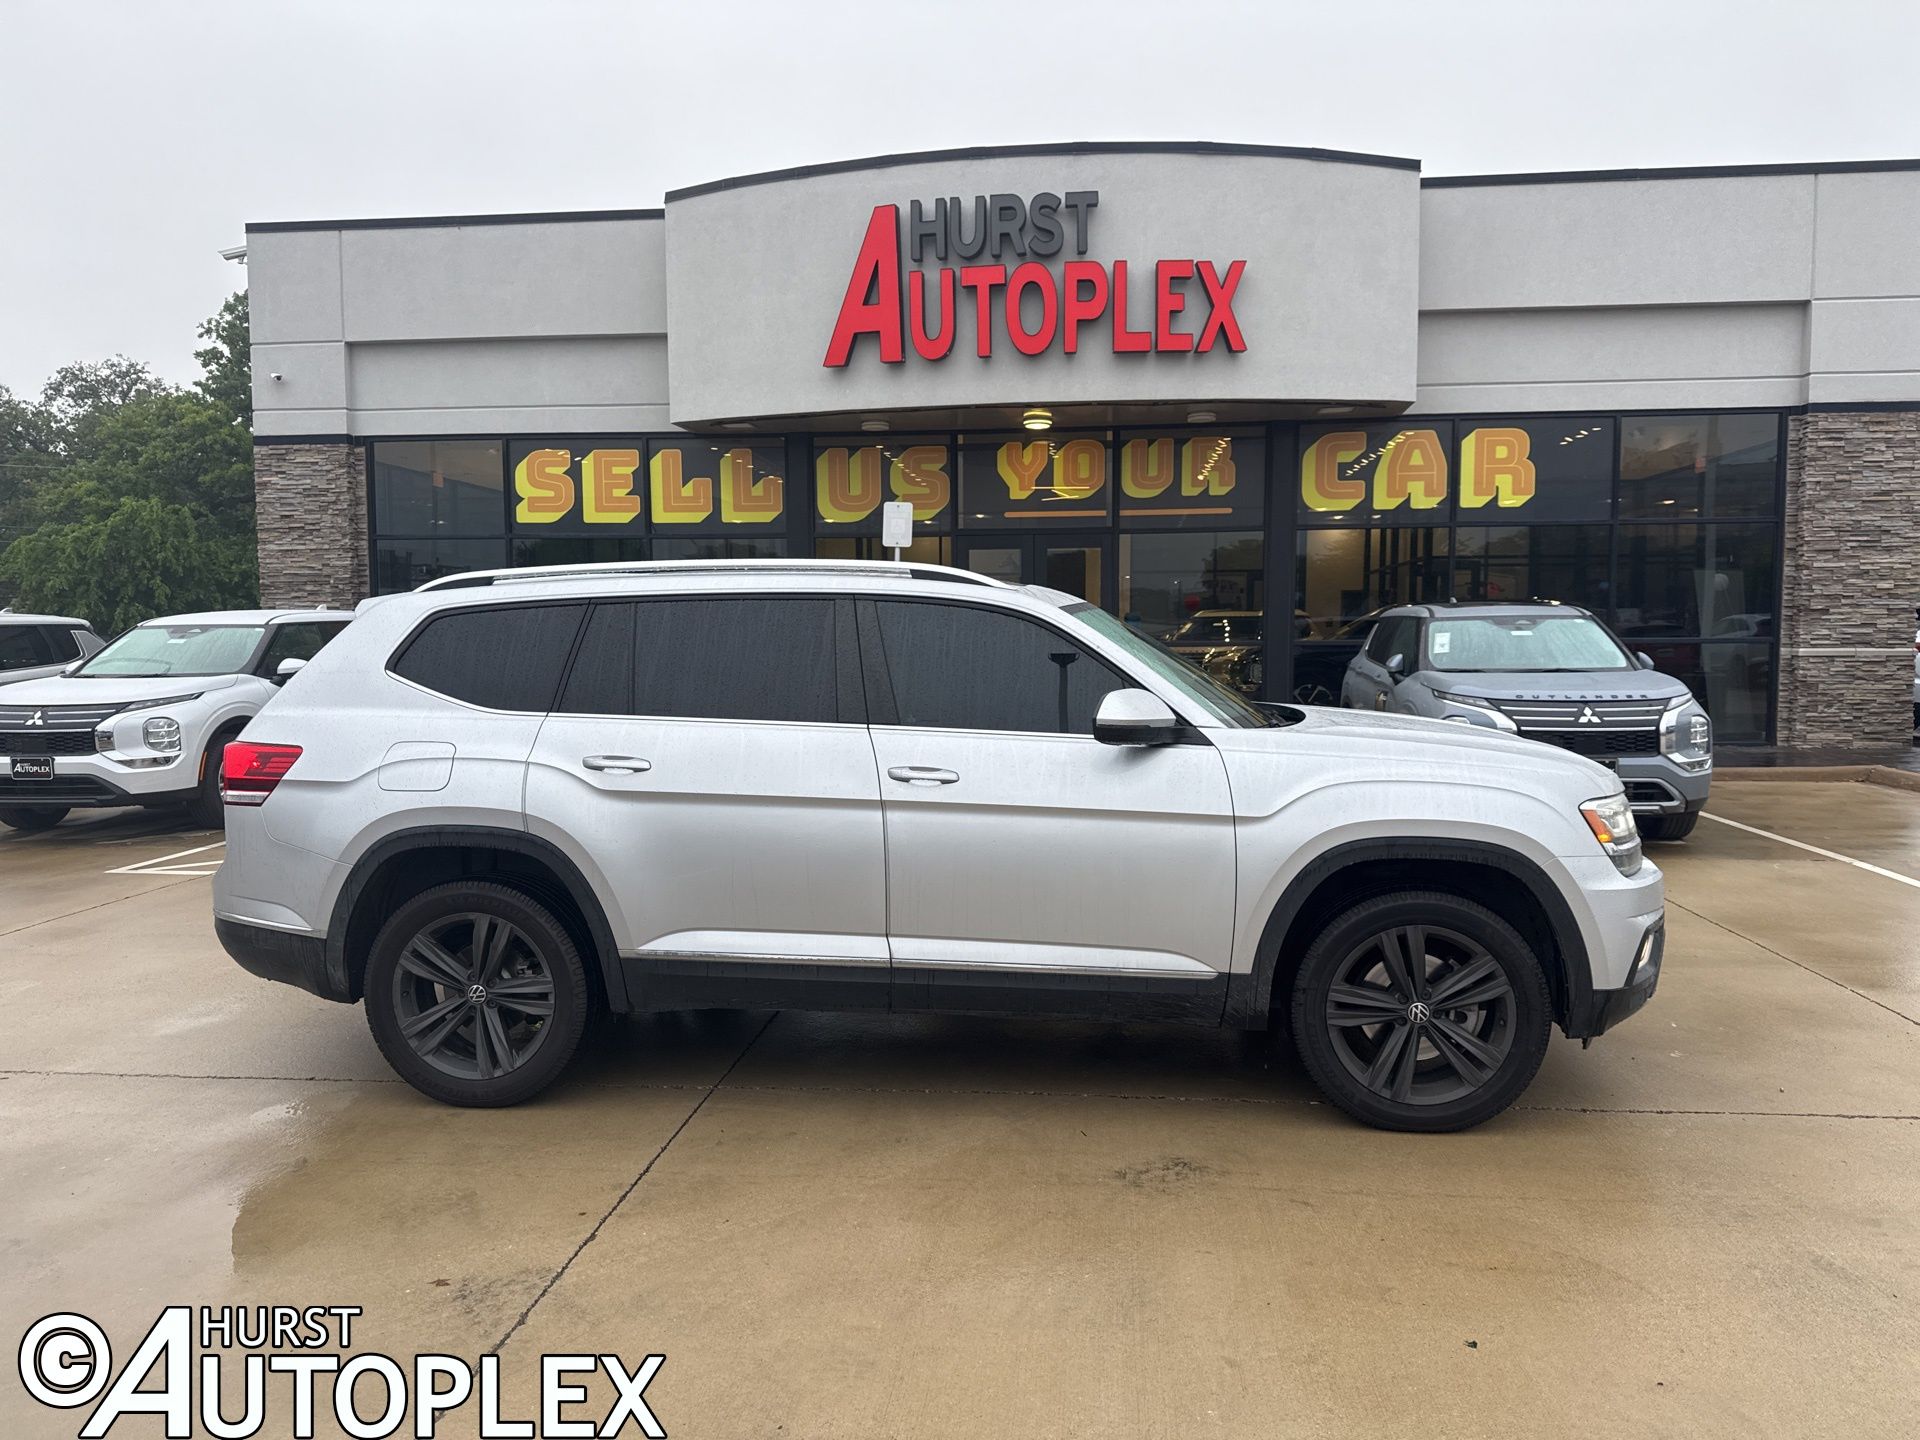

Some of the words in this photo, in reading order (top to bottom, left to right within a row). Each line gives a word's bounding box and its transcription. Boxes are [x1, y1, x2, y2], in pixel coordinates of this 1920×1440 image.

[910, 190, 1099, 262] HURST
[823, 204, 1248, 367] AUTOPLEX
[515, 448, 783, 523] SELL
[816, 445, 951, 523] US
[997, 438, 1236, 499] YOUR
[1302, 428, 1536, 510] CAR
[13, 763, 50, 773] AUTOPLEX
